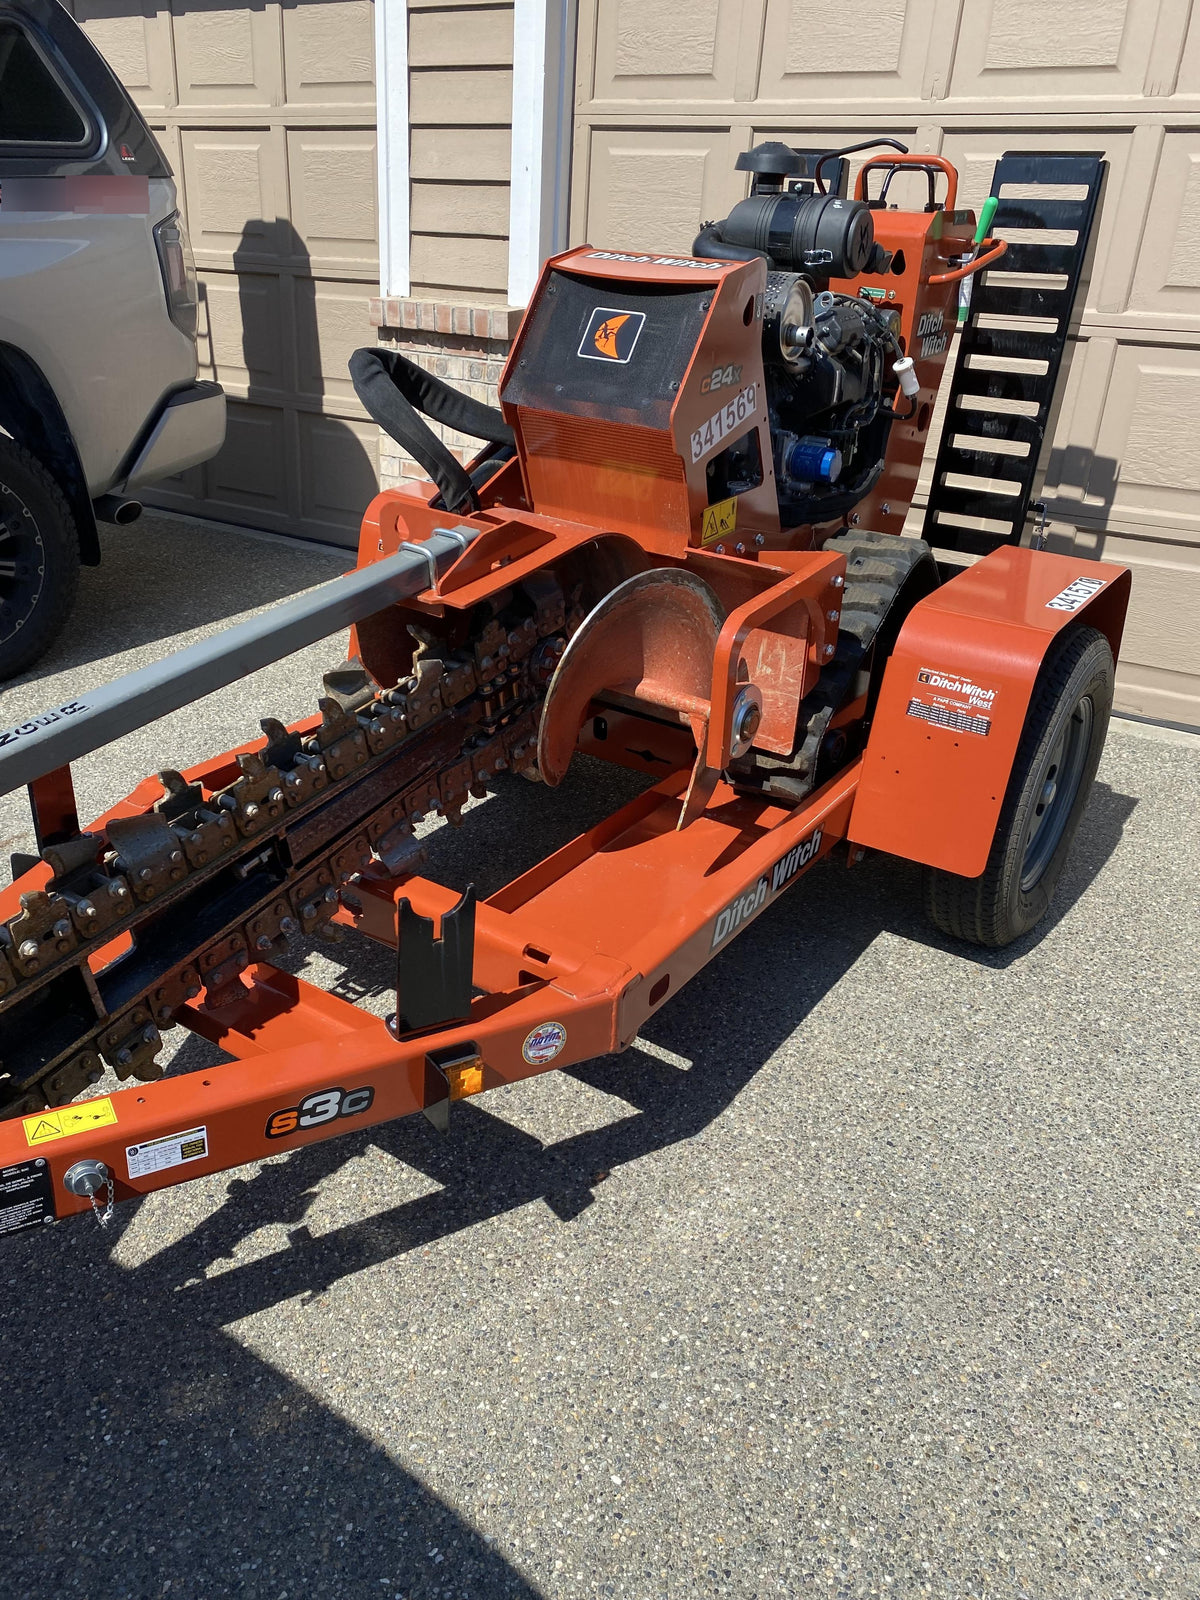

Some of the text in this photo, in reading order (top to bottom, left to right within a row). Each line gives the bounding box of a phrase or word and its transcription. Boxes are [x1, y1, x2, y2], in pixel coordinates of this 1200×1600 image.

[585, 252, 722, 270] Ditch Witch
[916, 311, 944, 337] Ditch
[920, 332, 947, 358] Witch
[692, 384, 757, 460] 341569
[949, 700, 972, 710] COMPANY
[968, 695, 993, 709] West
[712, 829, 822, 948] Ditch Witch
